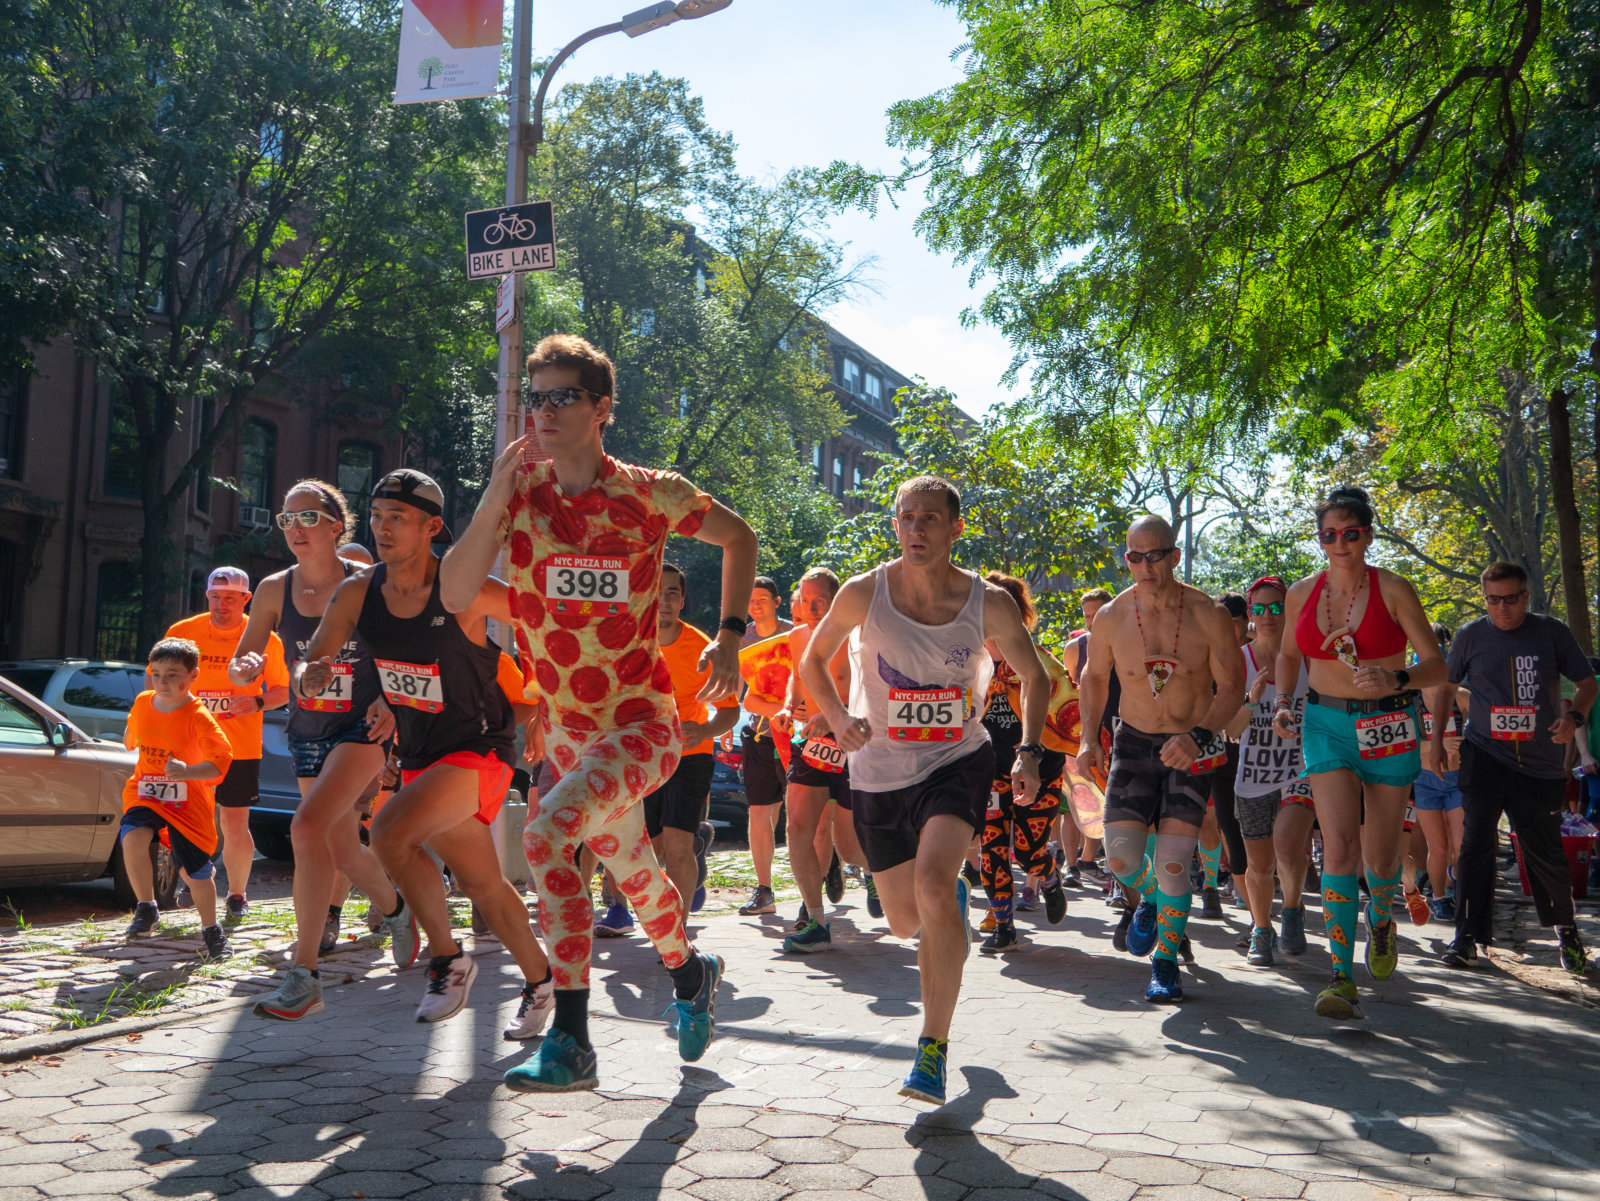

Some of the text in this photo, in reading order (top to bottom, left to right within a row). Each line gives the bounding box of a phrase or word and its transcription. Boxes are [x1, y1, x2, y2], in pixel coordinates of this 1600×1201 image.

[473, 246, 551, 272] BIKE LANE
[554, 557, 622, 568] NYC PIZZA RUN
[556, 569, 618, 598] 398
[201, 655, 230, 663] PIZZ
[380, 662, 433, 675] NYC PIZZA RUN
[386, 671, 431, 697] 387
[895, 691, 956, 701] NYC PIZZA RUN
[897, 702, 953, 725] 405
[1375, 716, 1394, 725] PIZZA
[1496, 715, 1531, 731] 354
[1365, 722, 1409, 747] 384
[808, 743, 842, 764] 400
[1244, 747, 1301, 768] LOVE
[1242, 767, 1299, 784] PIZZA
[145, 783, 179, 799] 371
[1286, 783, 1313, 798] 45
